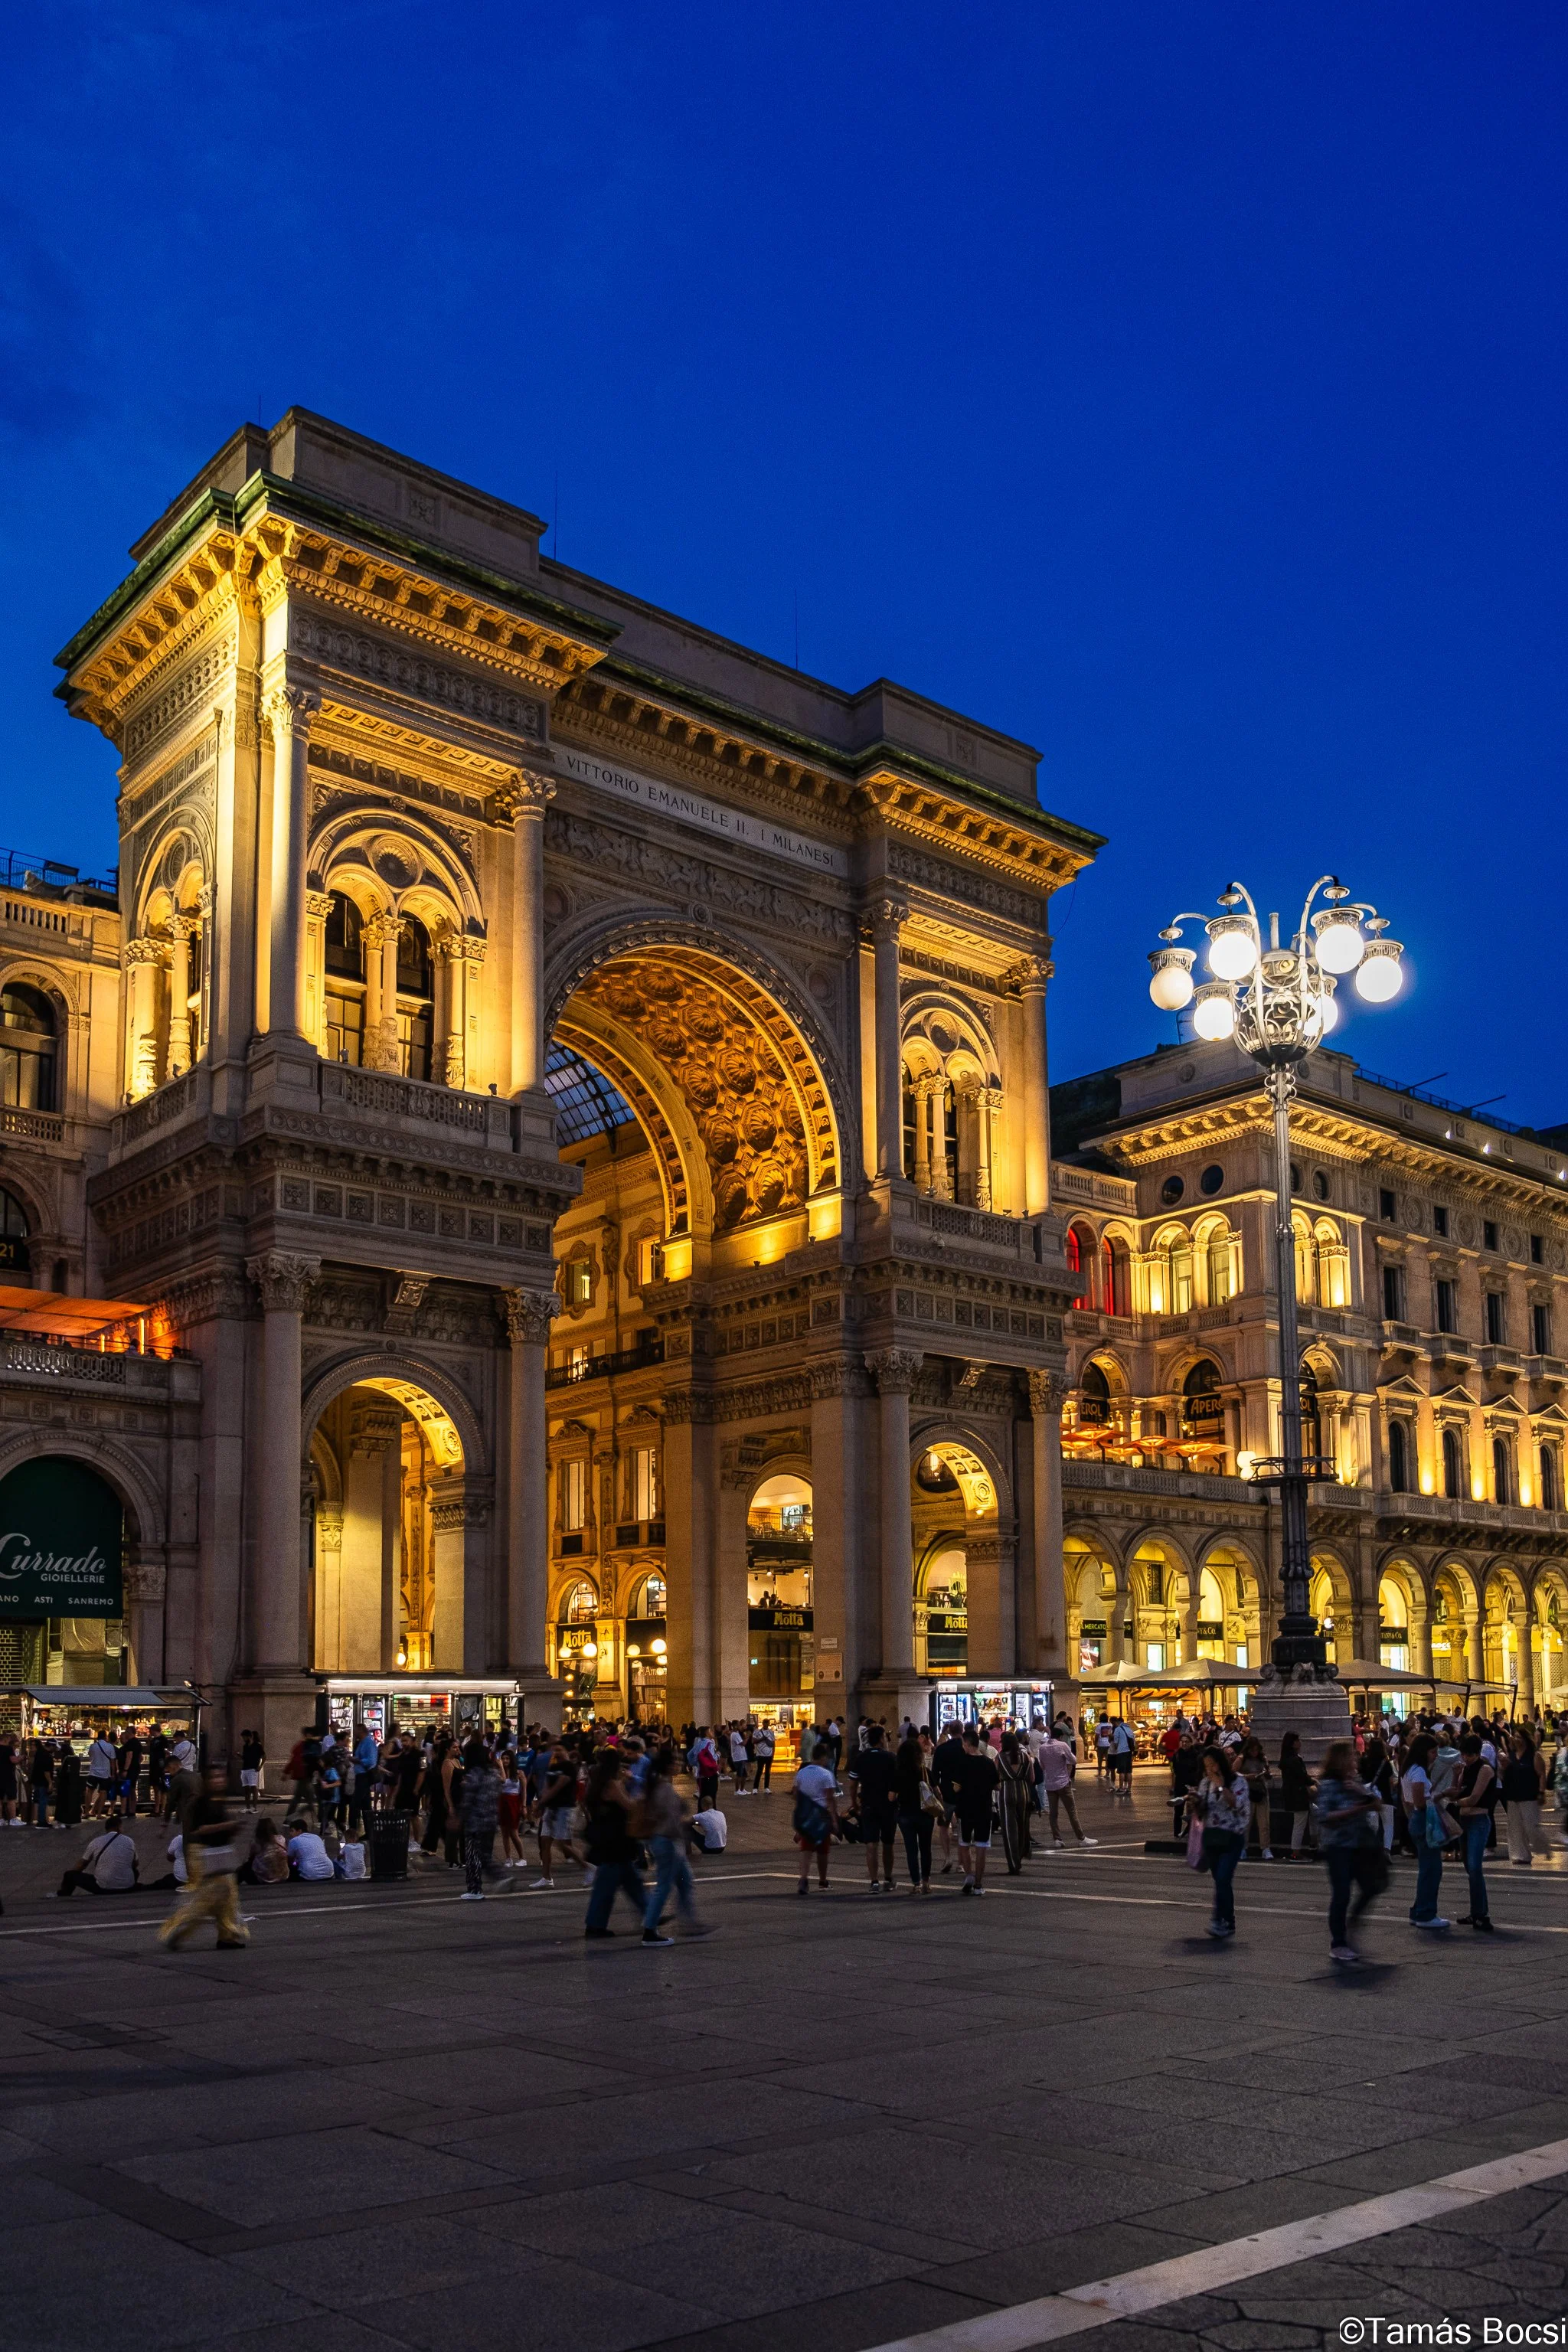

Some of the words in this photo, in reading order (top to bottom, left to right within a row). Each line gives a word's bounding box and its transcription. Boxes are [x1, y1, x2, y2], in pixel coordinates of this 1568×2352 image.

[567, 756, 639, 793] VITTORIO
[648, 786, 729, 828] EMANUELE
[761, 828, 764, 841] I
[773, 833, 834, 867] MILANESI
[41, 1573, 105, 1583] GIOIELLERIE
[67, 1597, 114, 1606] SANREMO
[774, 1612, 804, 1626] Motta
